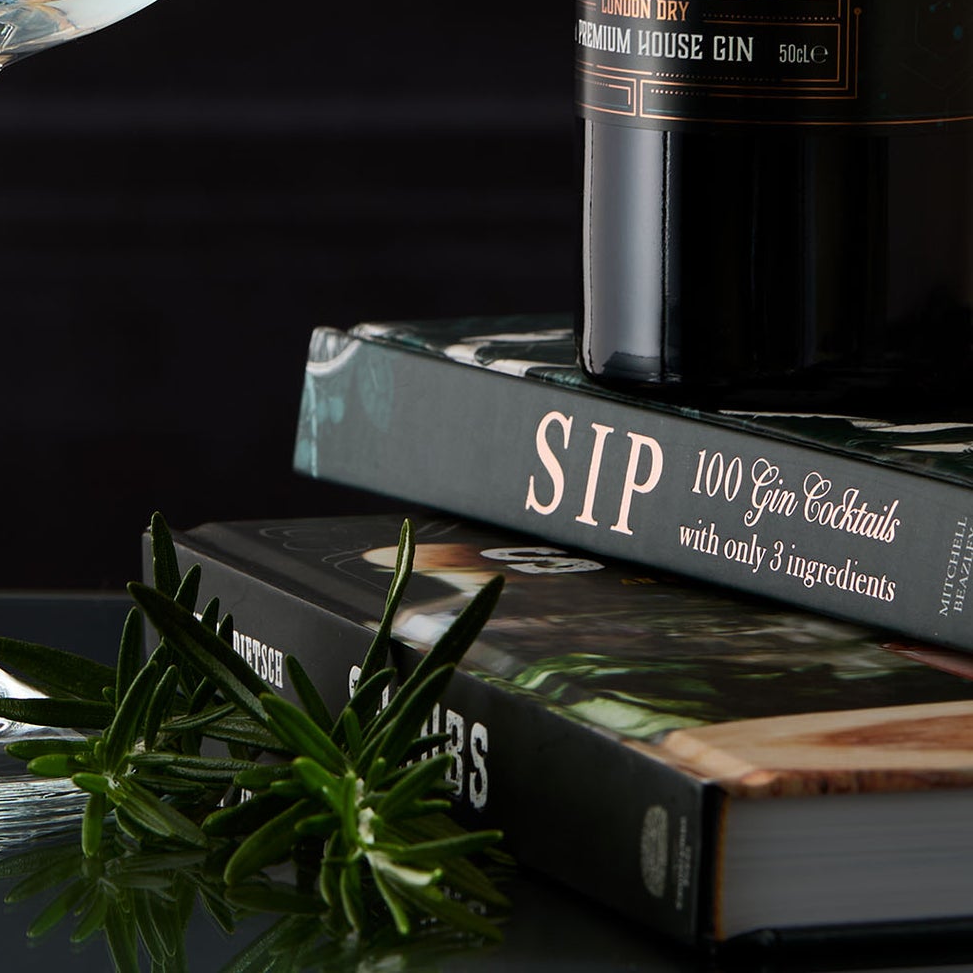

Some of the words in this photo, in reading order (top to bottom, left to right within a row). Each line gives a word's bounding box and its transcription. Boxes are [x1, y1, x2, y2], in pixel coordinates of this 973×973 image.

[578, 18, 631, 54] PREMIUM
[638, 30, 703, 60] HOUSE
[713, 36, 754, 62] GIN
[656, 0, 689, 22] DRY
[525, 410, 664, 536] SIP
[691, 449, 743, 502] 100
[744, 457, 798, 527] Gin
[803, 471, 900, 544] Cocktails
[679, 519, 719, 556] with
[723, 534, 767, 574] only
[769, 540, 784, 572] 3
[786, 543, 896, 603] ingredients
[939, 516, 968, 617] MITCHELL
